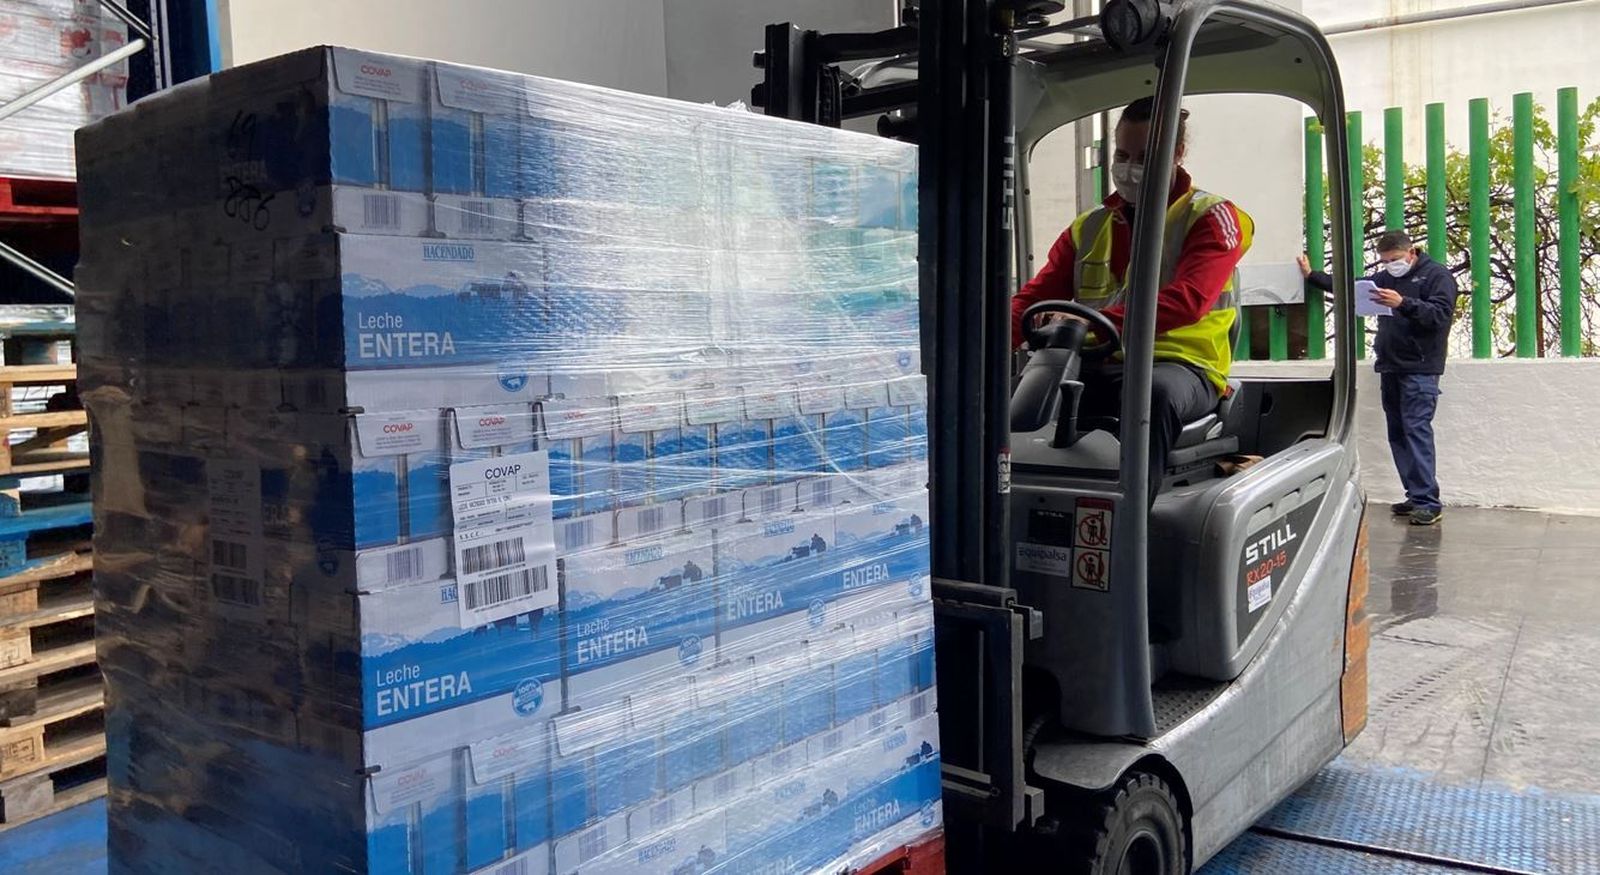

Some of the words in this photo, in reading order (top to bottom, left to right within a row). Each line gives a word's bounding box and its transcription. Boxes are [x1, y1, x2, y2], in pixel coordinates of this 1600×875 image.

[360, 63, 392, 78] COVAP
[1002, 135, 1015, 230] STILL
[423, 245, 475, 260] HACENDADO
[358, 311, 403, 329] Leche
[359, 331, 456, 359] ENTERA
[383, 422, 414, 434] COVAP
[478, 416, 506, 427] COVAP
[485, 464, 522, 480] COVAP
[1245, 523, 1297, 566] STILL
[842, 563, 889, 589] ENTERA
[727, 589, 784, 621] ENTERA
[577, 618, 610, 637] Leche
[577, 626, 649, 664] ENTERA
[376, 663, 421, 687] Leche
[376, 670, 472, 716] ENTERA
[855, 800, 900, 833] ENTERA
